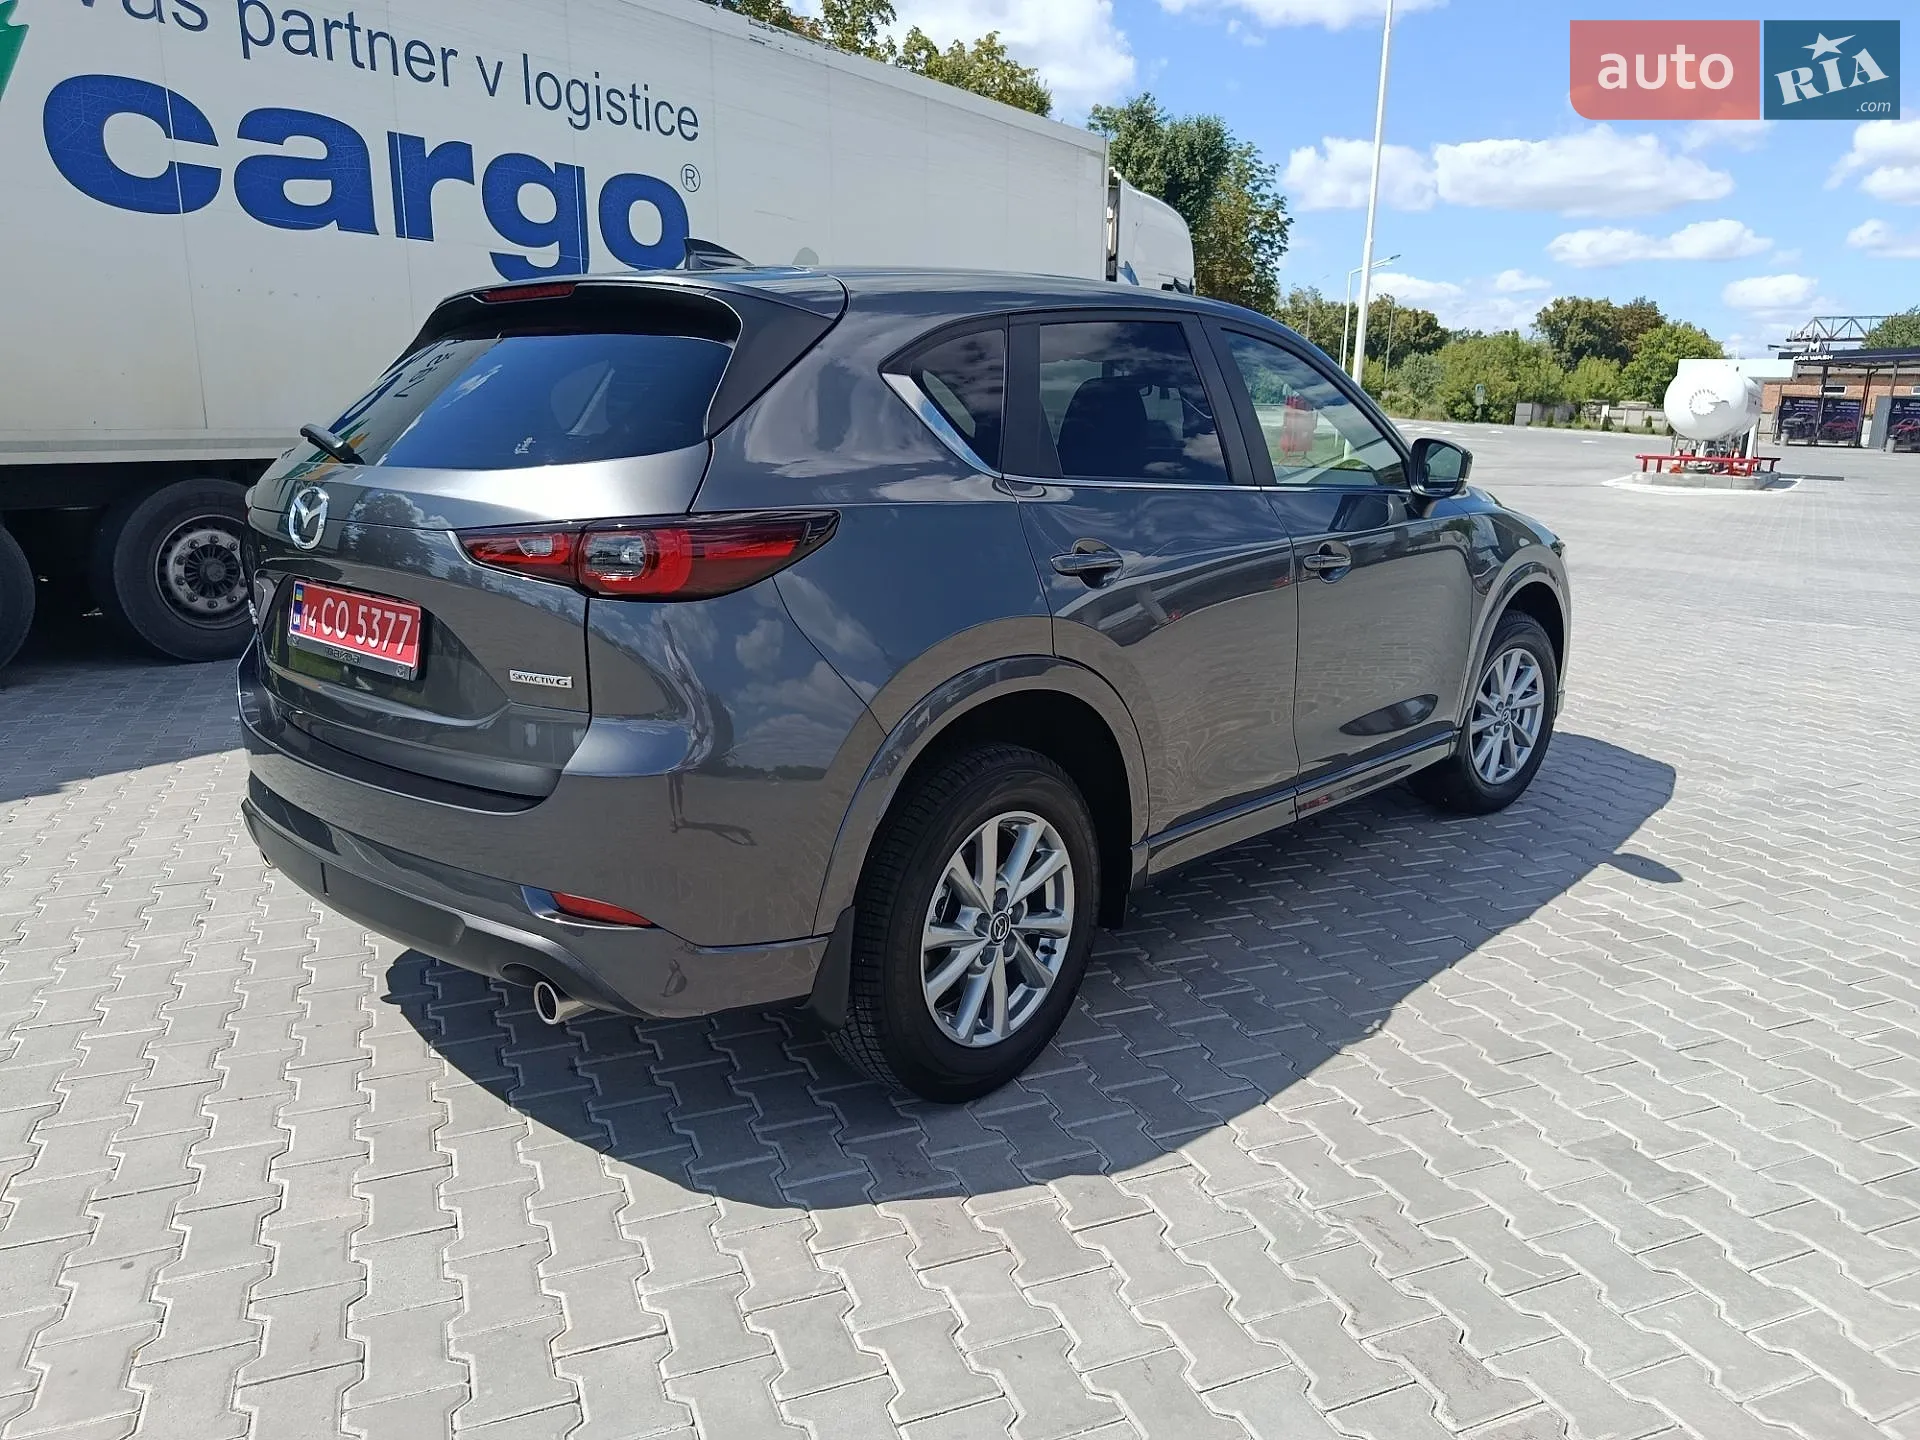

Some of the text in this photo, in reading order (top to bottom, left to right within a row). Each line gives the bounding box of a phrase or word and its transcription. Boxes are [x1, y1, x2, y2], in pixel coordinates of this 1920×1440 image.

[236, 0, 460, 88] partner
[476, 56, 504, 98] v
[522, 53, 700, 142] logistice
[42, 73, 692, 283] cargo
[355, 604, 413, 655] 5377
